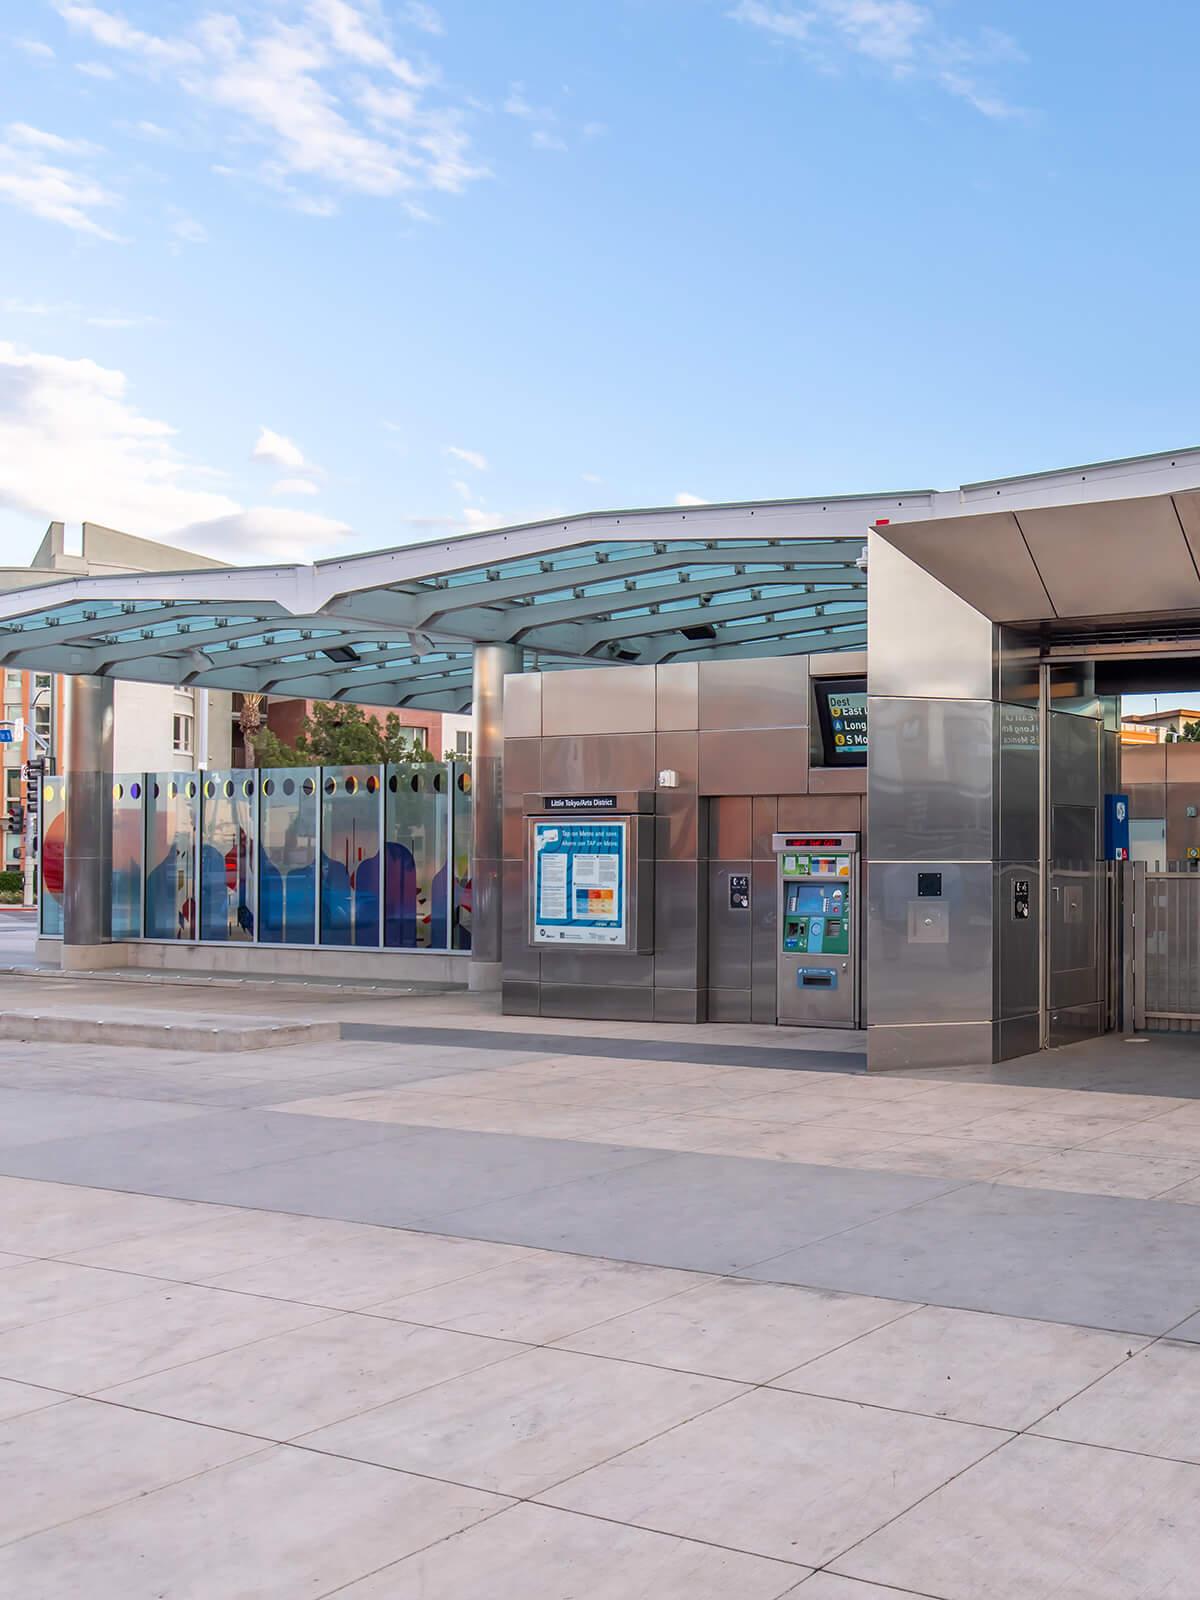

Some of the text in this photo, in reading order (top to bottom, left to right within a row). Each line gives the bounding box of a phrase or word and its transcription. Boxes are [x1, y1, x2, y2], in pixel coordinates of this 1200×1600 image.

[830, 697, 851, 707] Dest
[842, 707, 862, 716] East
[844, 720, 867, 732] Long
[846, 734, 853, 745] S
[550, 799, 565, 807] Little
[565, 799, 593, 808] Tokyo/Arts
[562, 830, 570, 838] Tap
